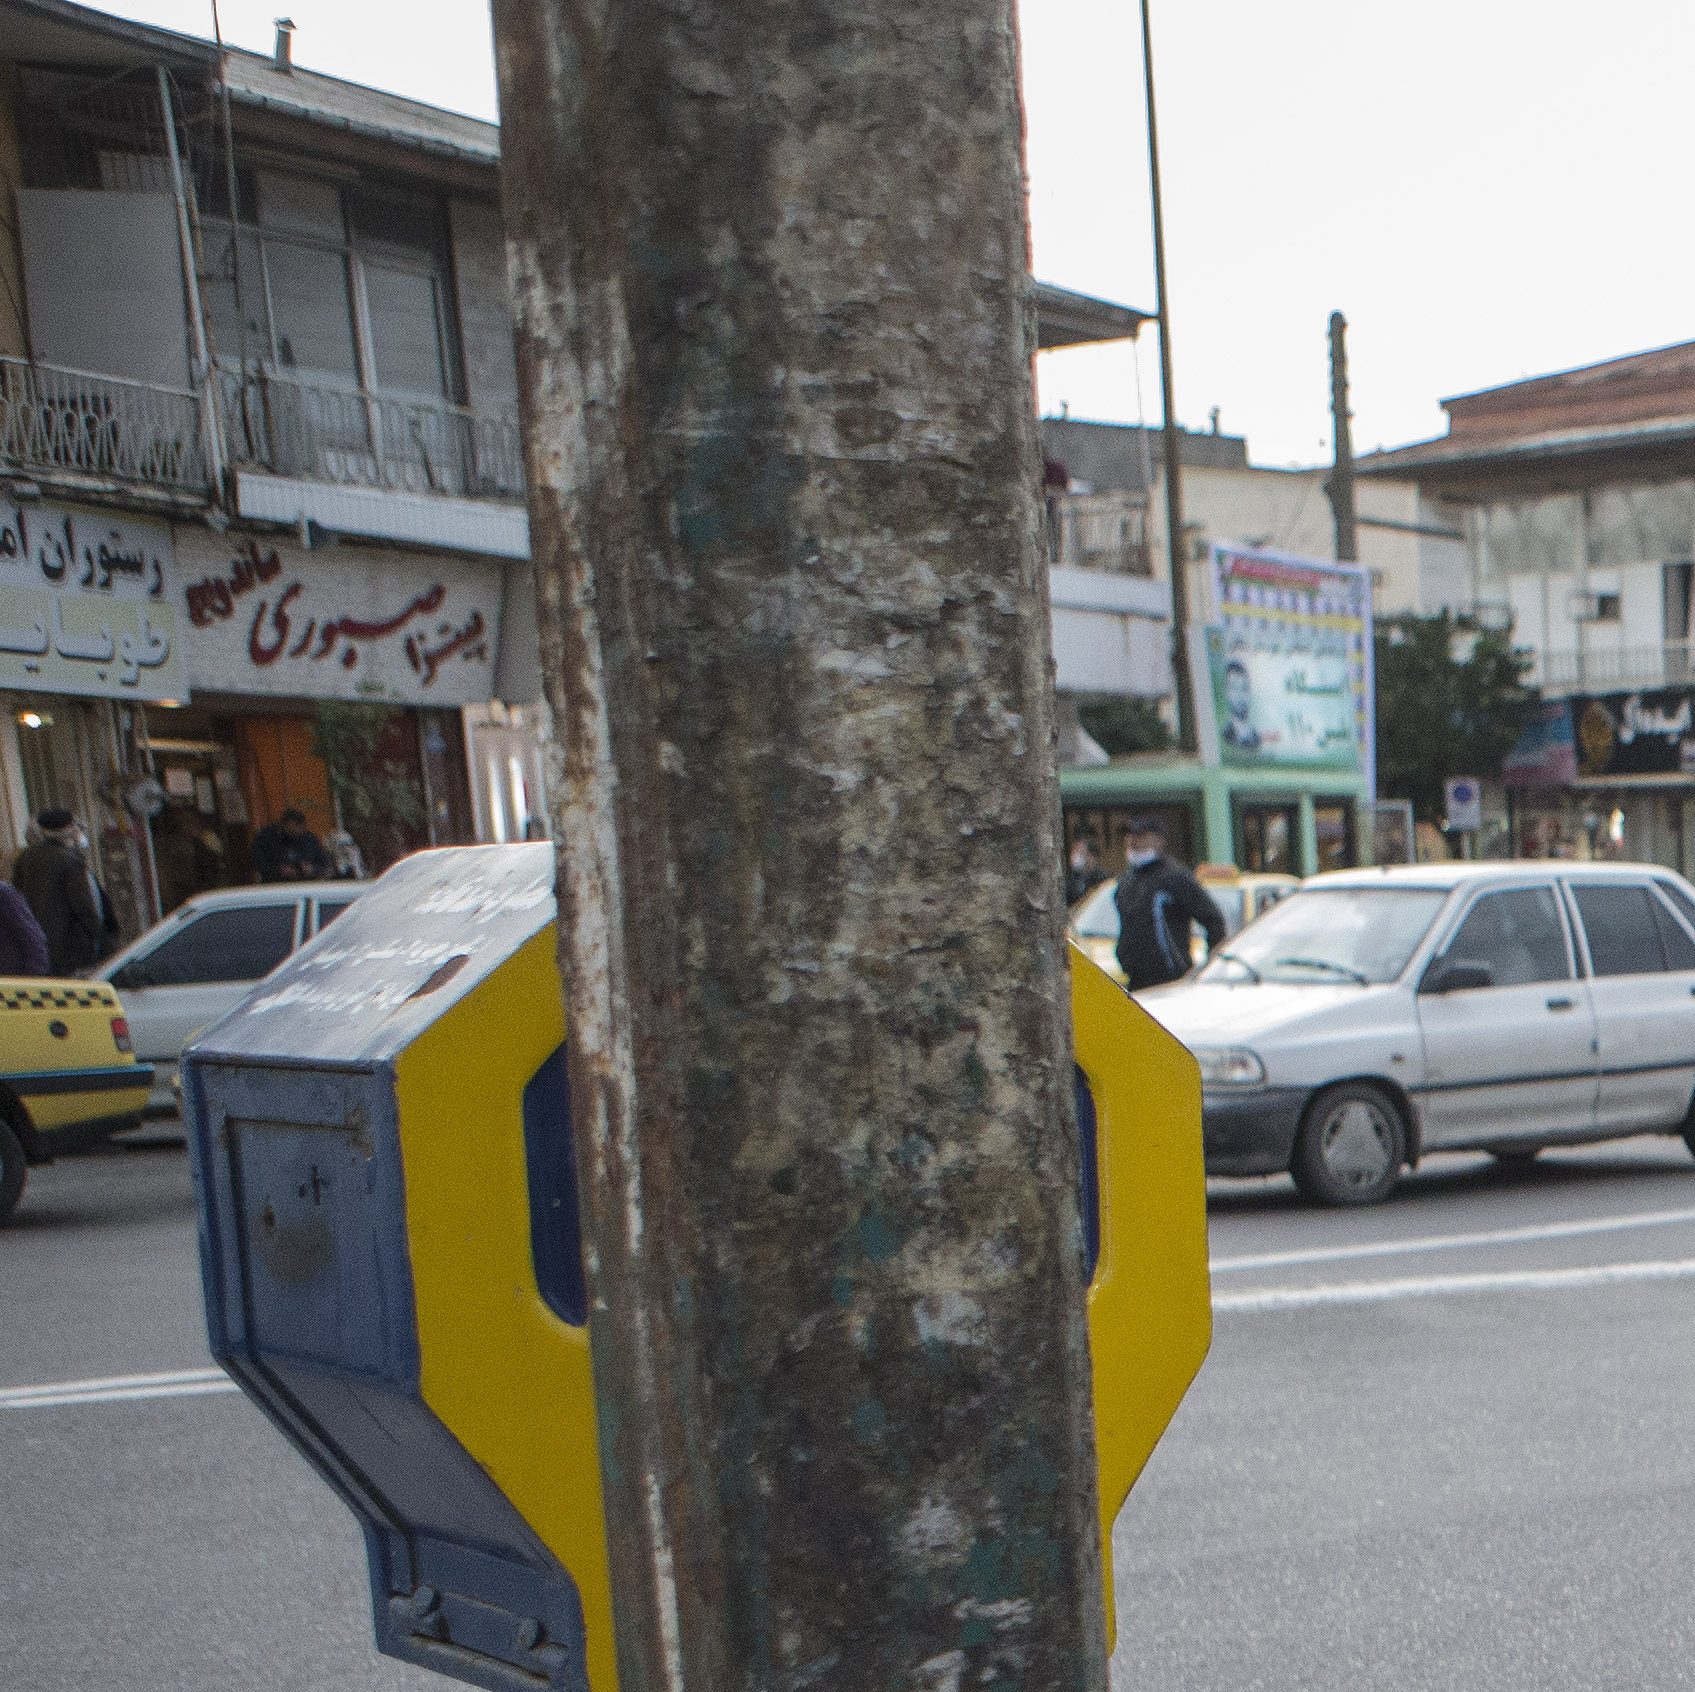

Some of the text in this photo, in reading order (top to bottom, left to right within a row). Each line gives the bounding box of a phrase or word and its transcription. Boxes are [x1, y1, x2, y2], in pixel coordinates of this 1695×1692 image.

[40, 514, 163, 596] رستوران
[249, 582, 447, 669] صبوری
[405, 609, 488, 687] پیتزا
